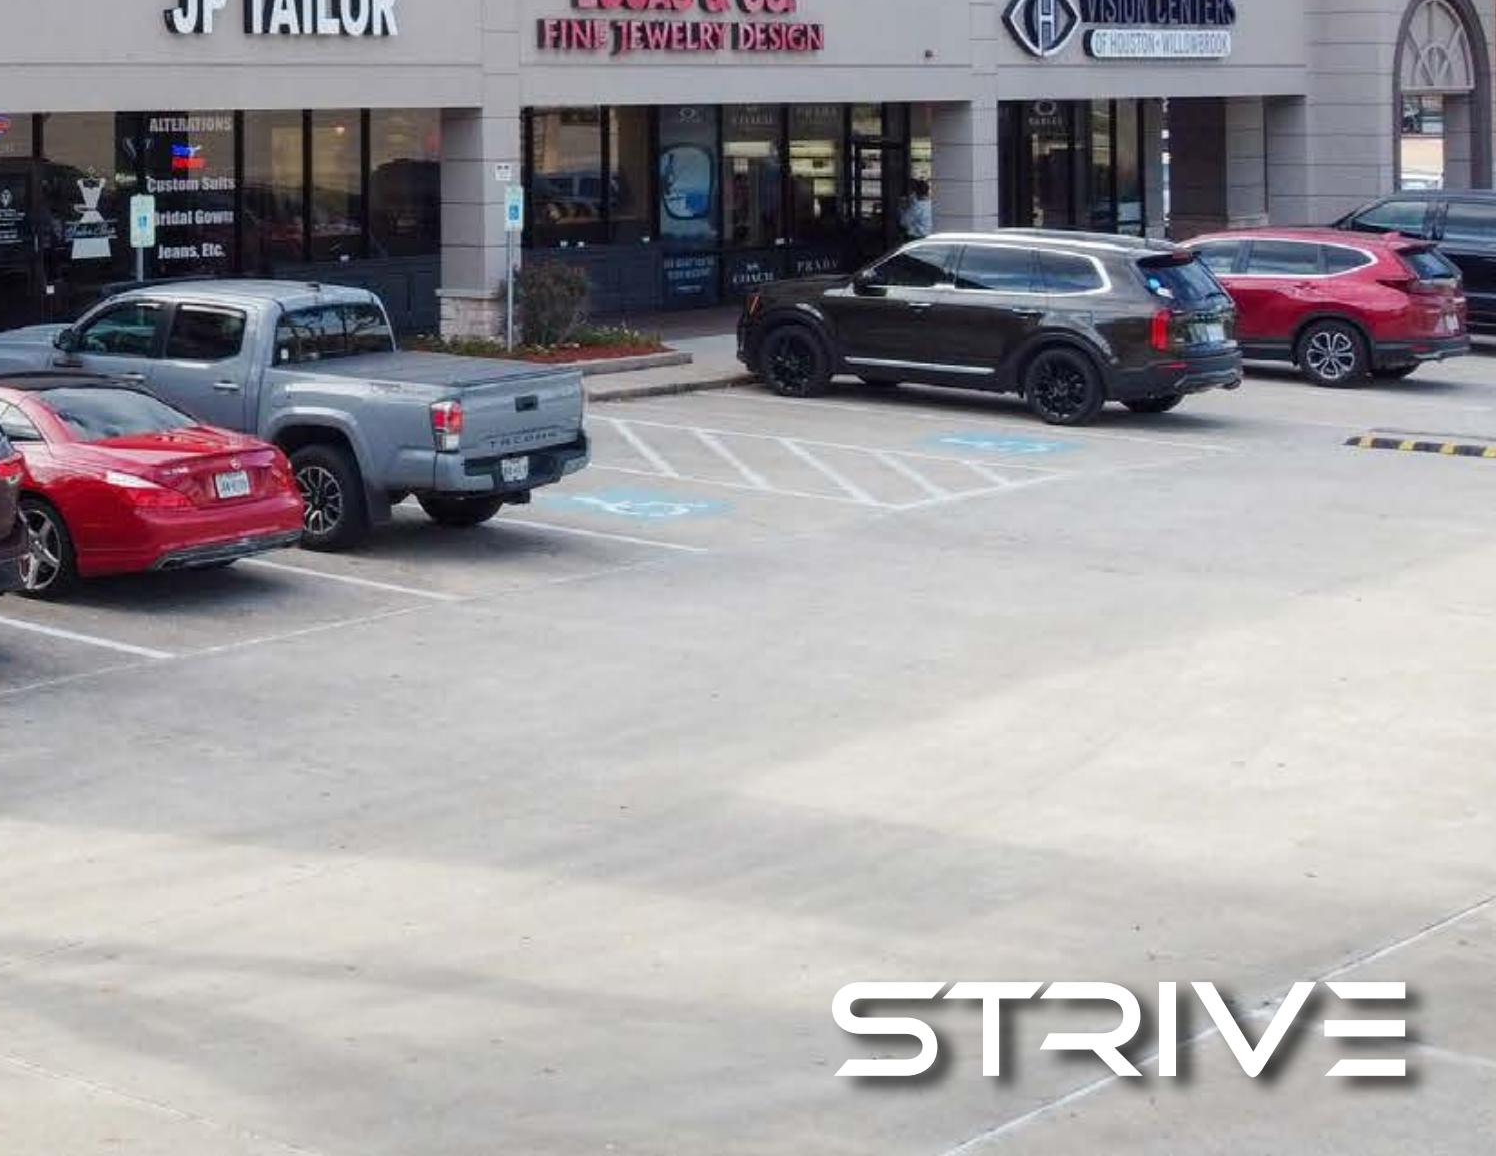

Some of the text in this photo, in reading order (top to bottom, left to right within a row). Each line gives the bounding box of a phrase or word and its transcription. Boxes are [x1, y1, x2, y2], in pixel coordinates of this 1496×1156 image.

[537, 18, 824, 55] FINE JEWELRY DESIGN
[1095, 32, 1108, 54] OF
[1111, 32, 1152, 54] HOUSTON
[149, 116, 233, 133] ALTERATIONS
[147, 176, 199, 194] Custom
[201, 175, 236, 191] Suits
[157, 244, 200, 260] Jeans,
